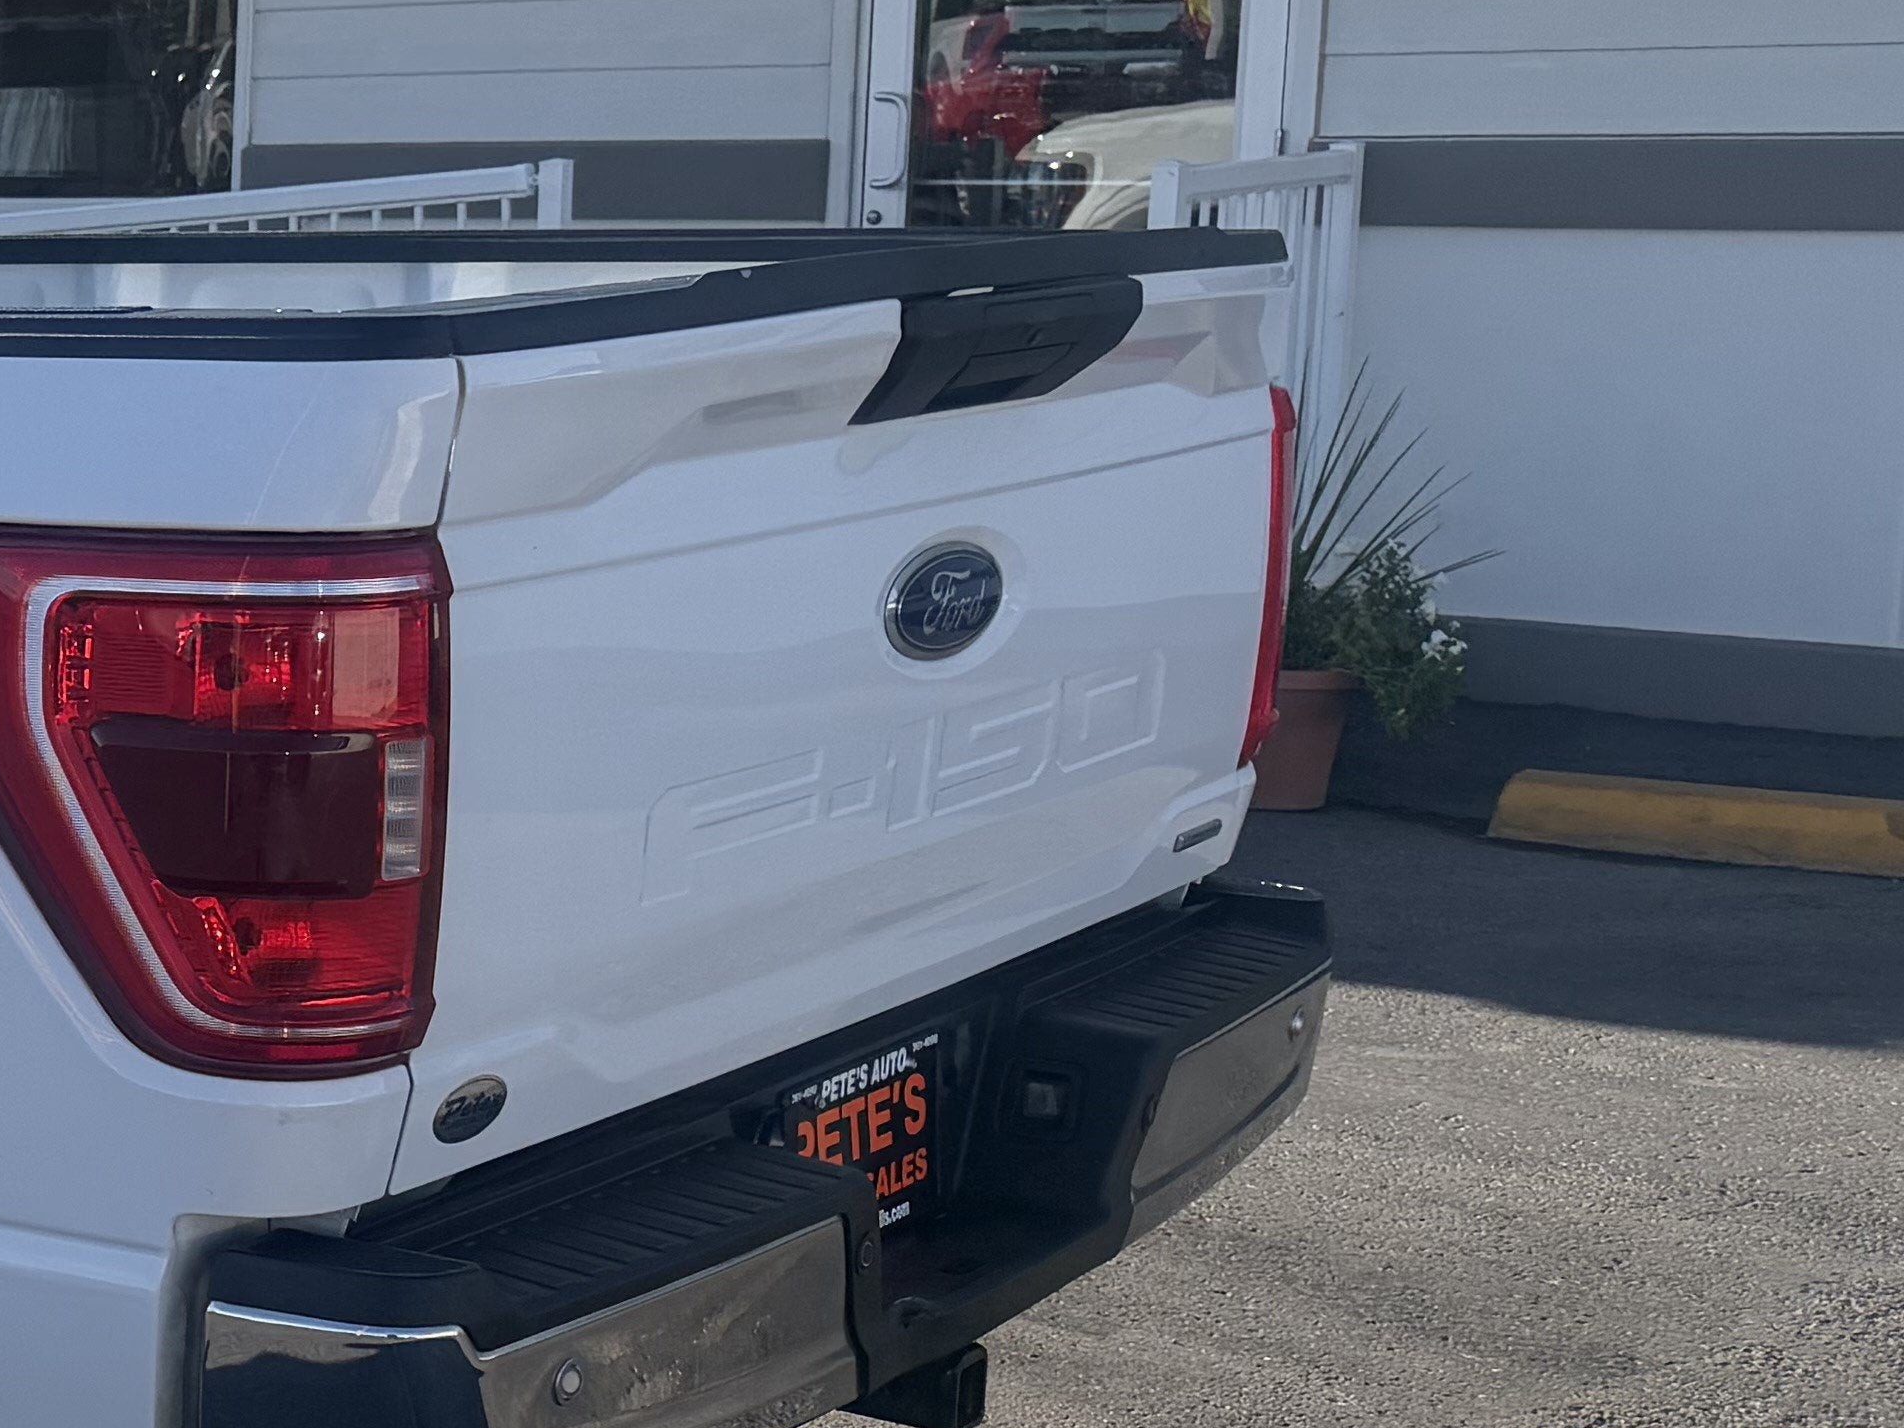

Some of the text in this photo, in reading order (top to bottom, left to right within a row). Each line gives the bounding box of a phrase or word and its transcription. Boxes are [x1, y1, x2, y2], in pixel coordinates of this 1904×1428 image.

[923, 570, 987, 635] Ford
[821, 1063, 869, 1104] PETE'S
[870, 1047, 907, 1086] AUTO
[867, 1147, 928, 1200] ALES
